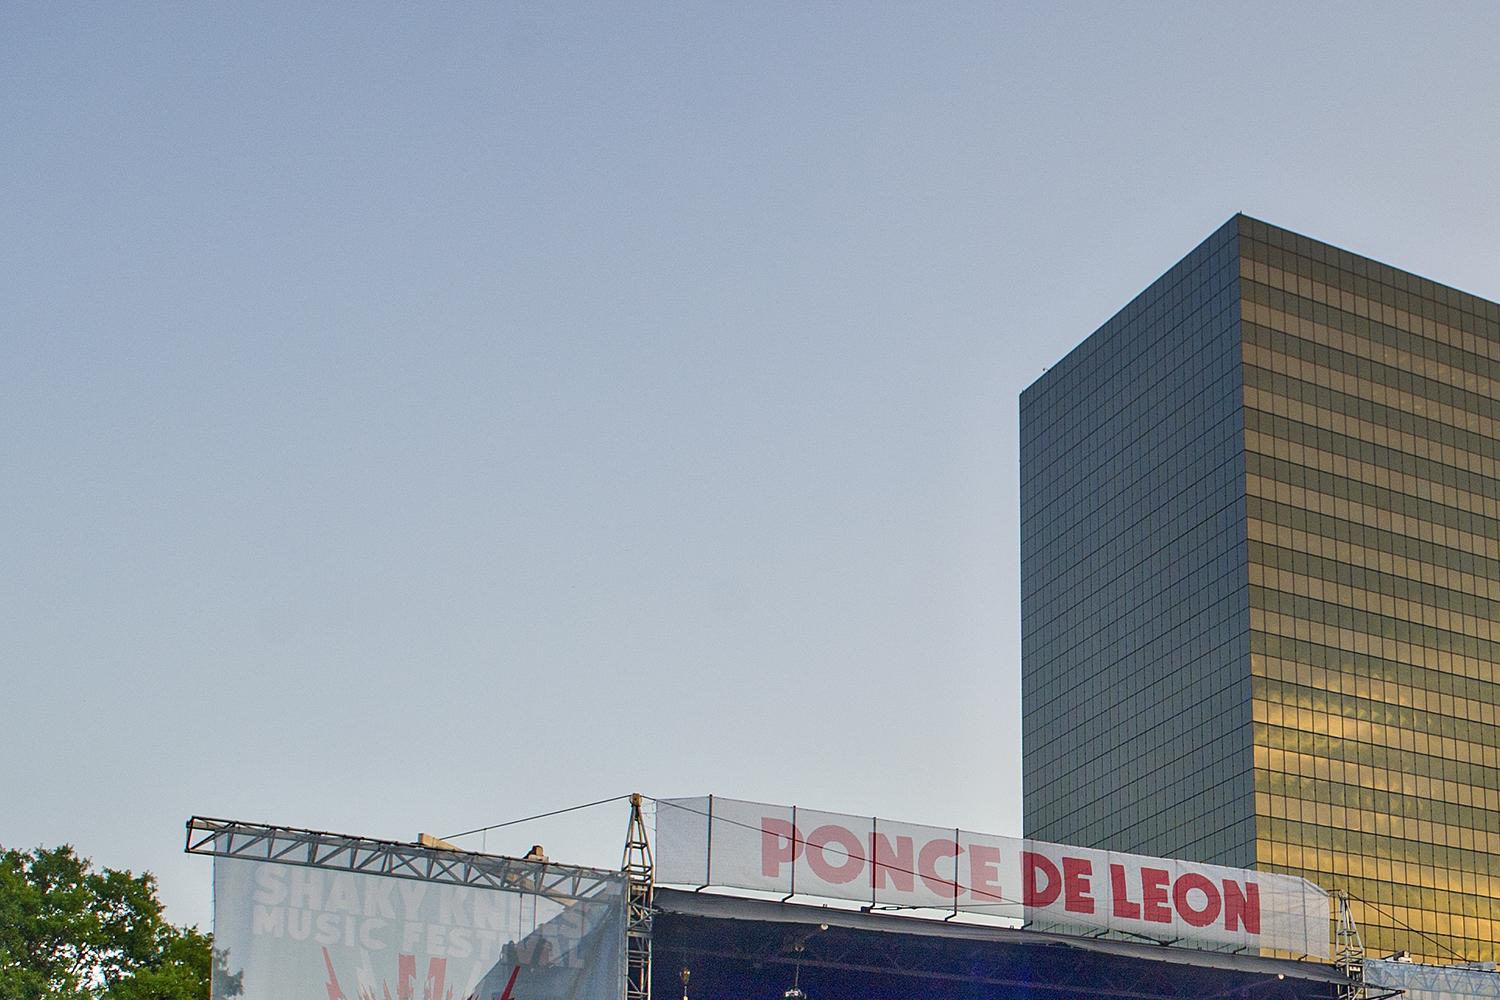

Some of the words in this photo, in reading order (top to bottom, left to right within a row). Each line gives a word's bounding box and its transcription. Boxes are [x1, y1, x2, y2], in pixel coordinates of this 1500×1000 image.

[252, 864, 428, 920] SHAKY
[761, 816, 1003, 903] PONCE
[1020, 850, 1096, 915] DE
[1109, 863, 1262, 936] LEON
[251, 903, 388, 951] MUSIC
